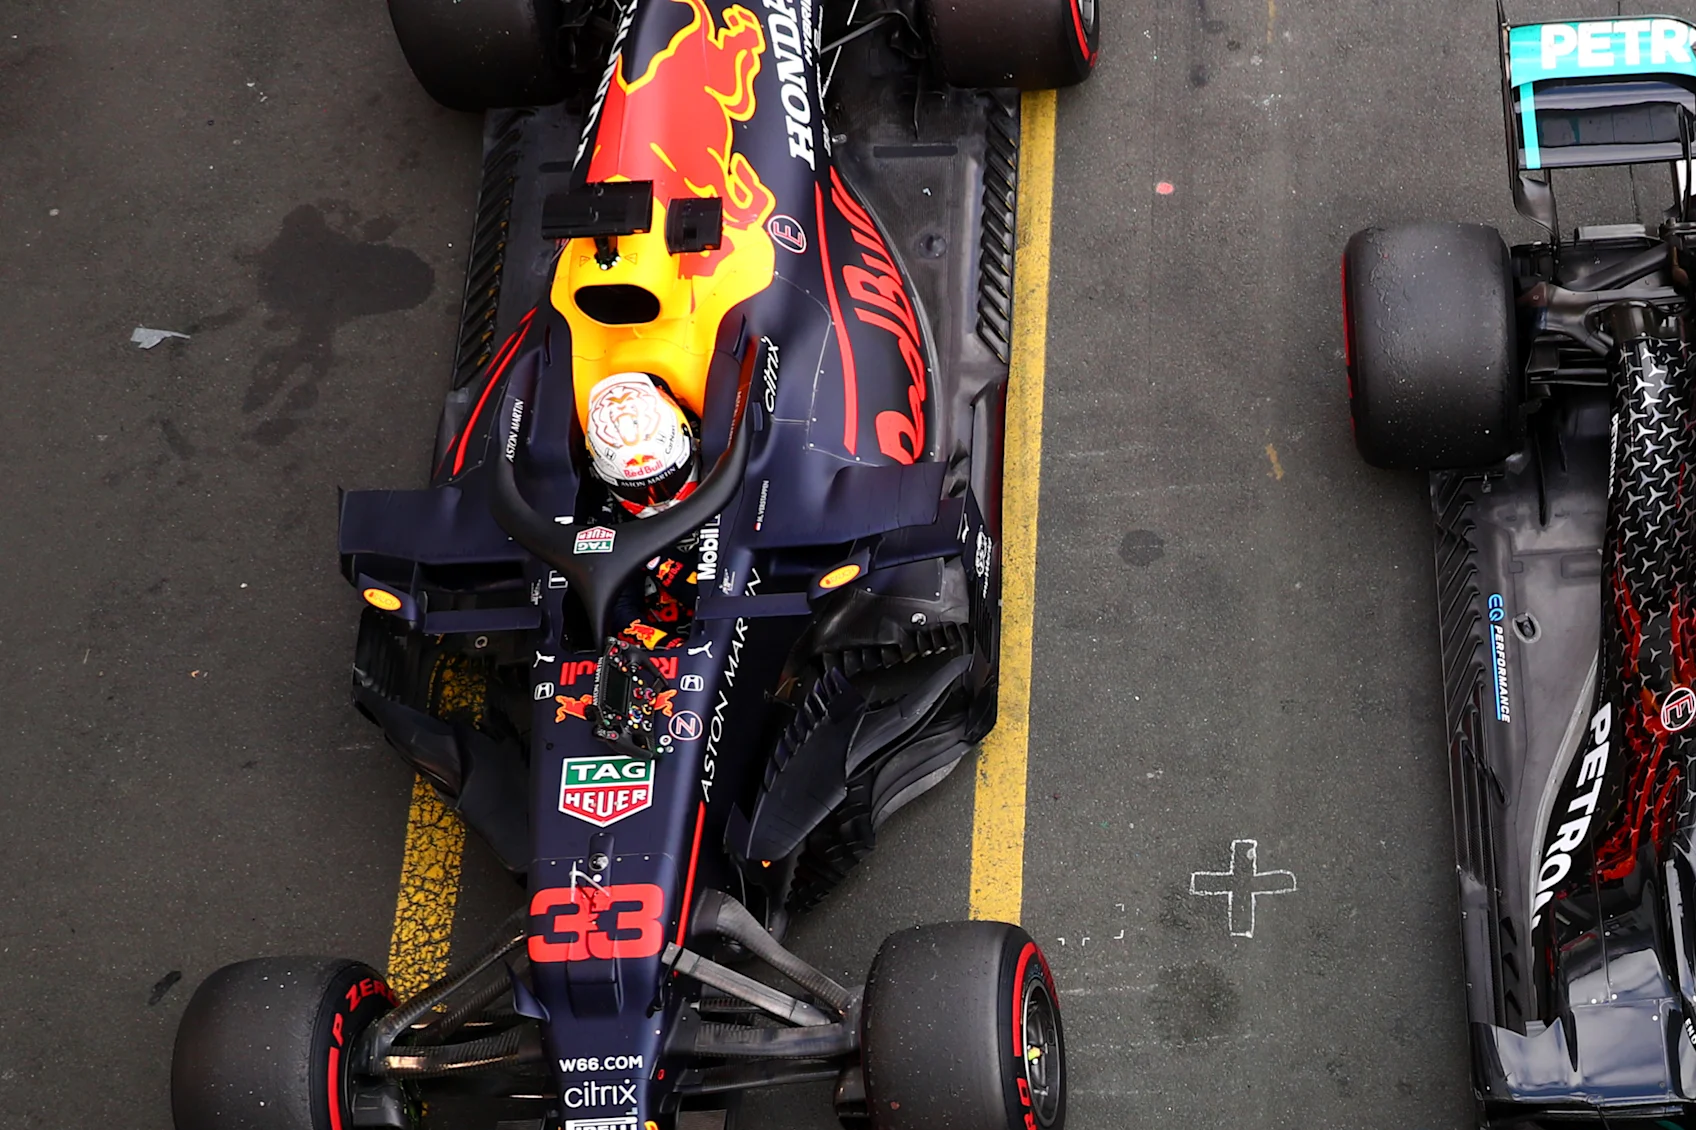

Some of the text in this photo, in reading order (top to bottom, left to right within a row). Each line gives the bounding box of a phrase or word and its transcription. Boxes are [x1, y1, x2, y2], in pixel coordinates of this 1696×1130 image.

[765, 336, 779, 412] citrix
[505, 398, 525, 462] ASTON MARTIN
[623, 461, 663, 479] Red Bull
[577, 541, 612, 551] TAG
[697, 526, 720, 580] Mobil
[701, 691, 728, 802] ASTON
[724, 568, 761, 687] MARN
[1493, 624, 1511, 723] PERFORMANCE
[570, 761, 647, 782] TAG
[565, 789, 647, 818] HEUER
[527, 883, 665, 963] 33
[332, 1013, 345, 1046] P
[559, 1055, 644, 1072] W66.COM
[564, 1078, 638, 1108] citrix
